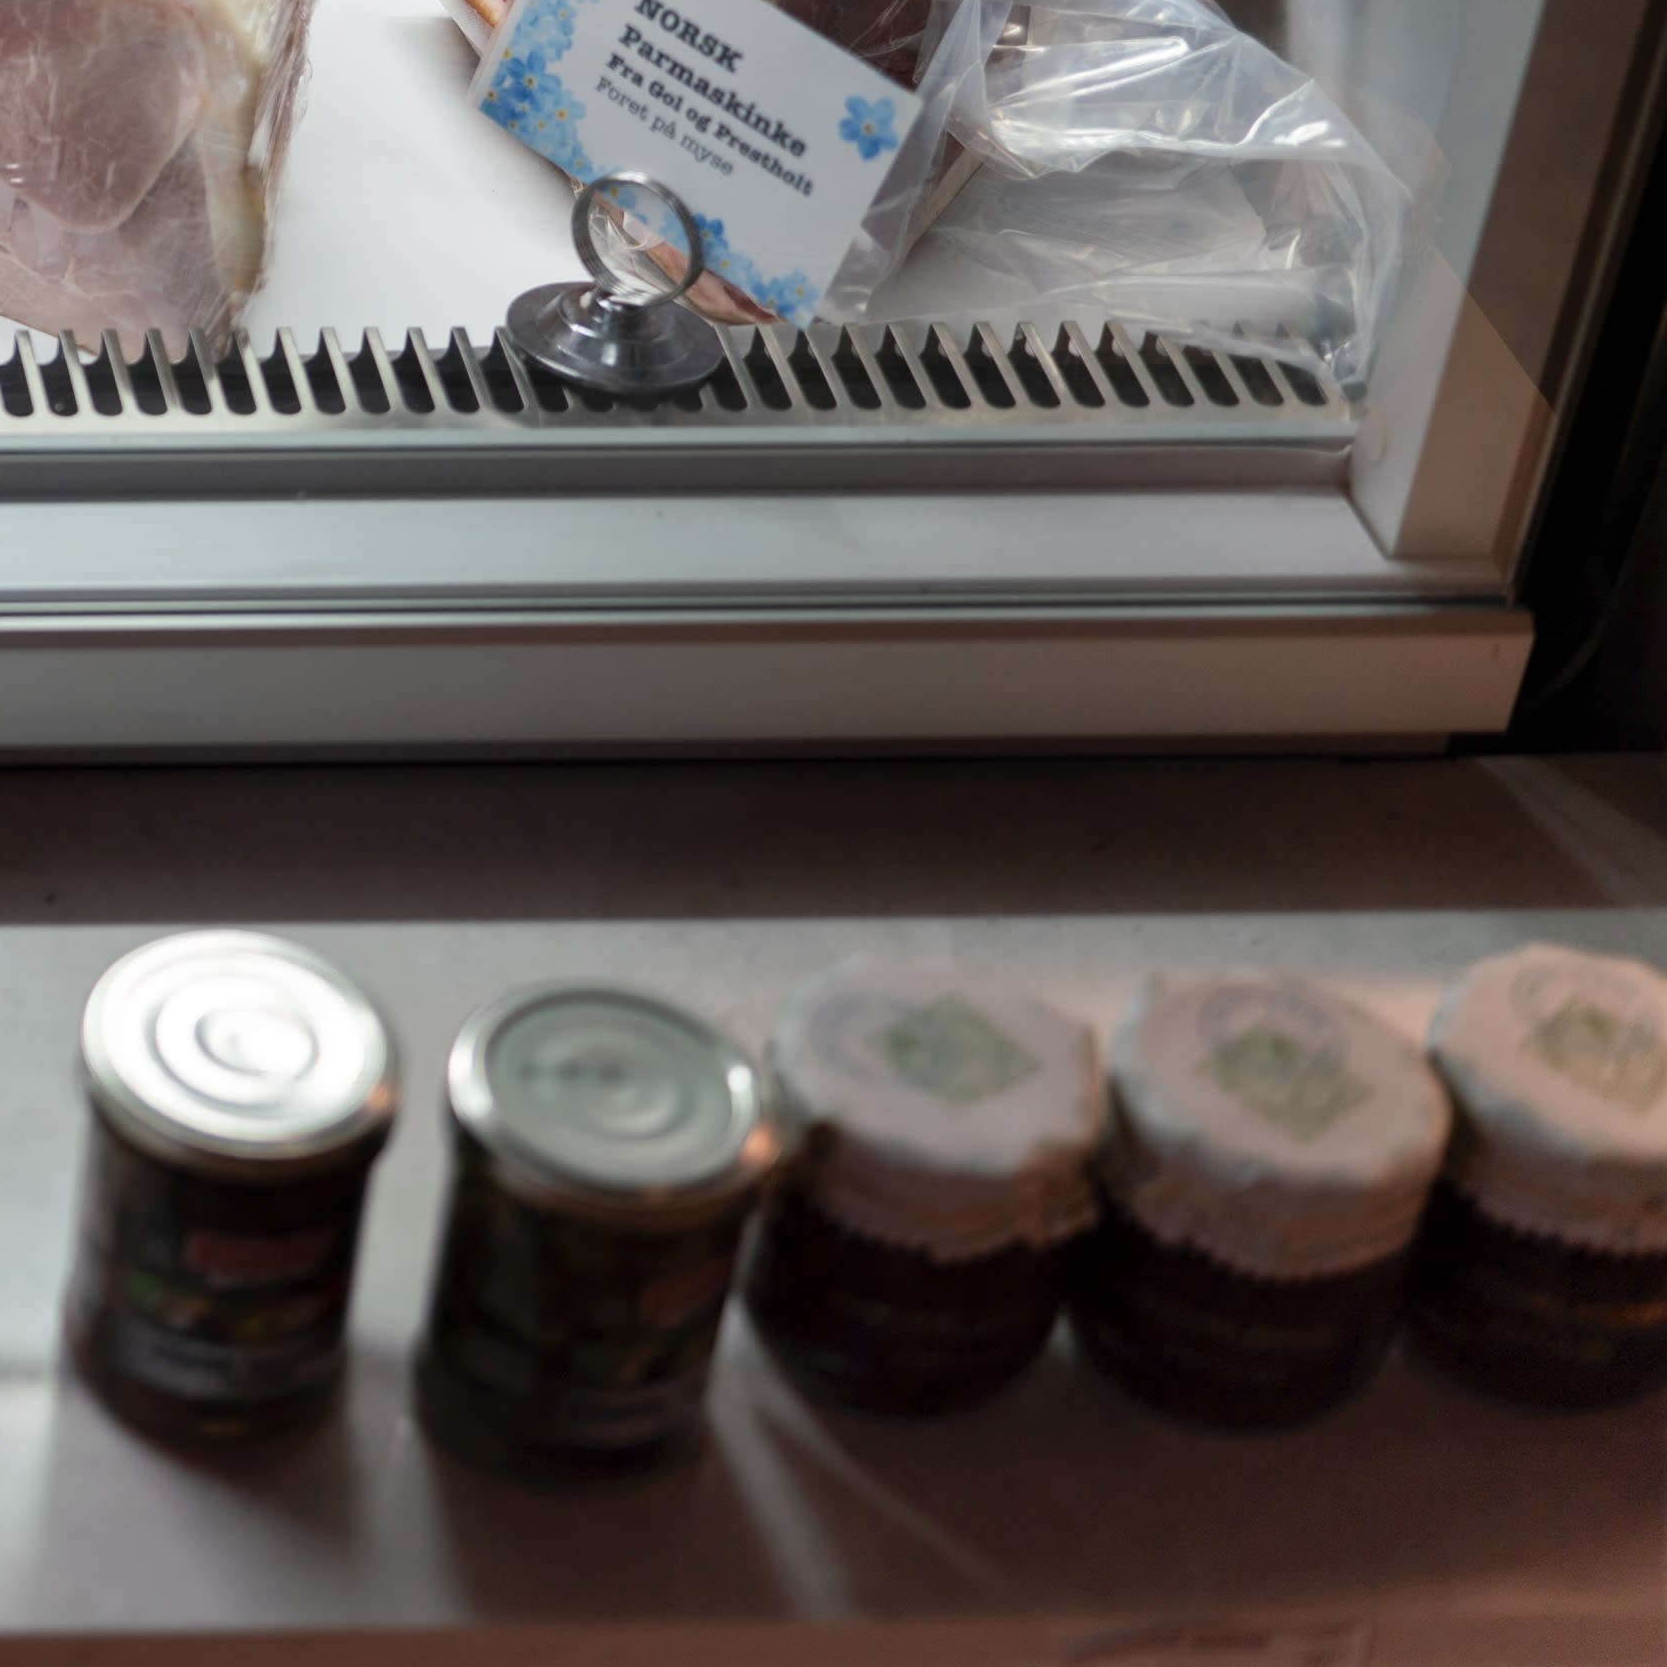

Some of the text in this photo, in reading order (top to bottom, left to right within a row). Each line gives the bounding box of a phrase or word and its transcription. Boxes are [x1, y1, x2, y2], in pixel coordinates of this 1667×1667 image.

[594, 76, 735, 176] Foret på myse
[606, 53, 813, 197] Fra Gol og Prestholt
[618, 24, 807, 158] Parmaskinke
